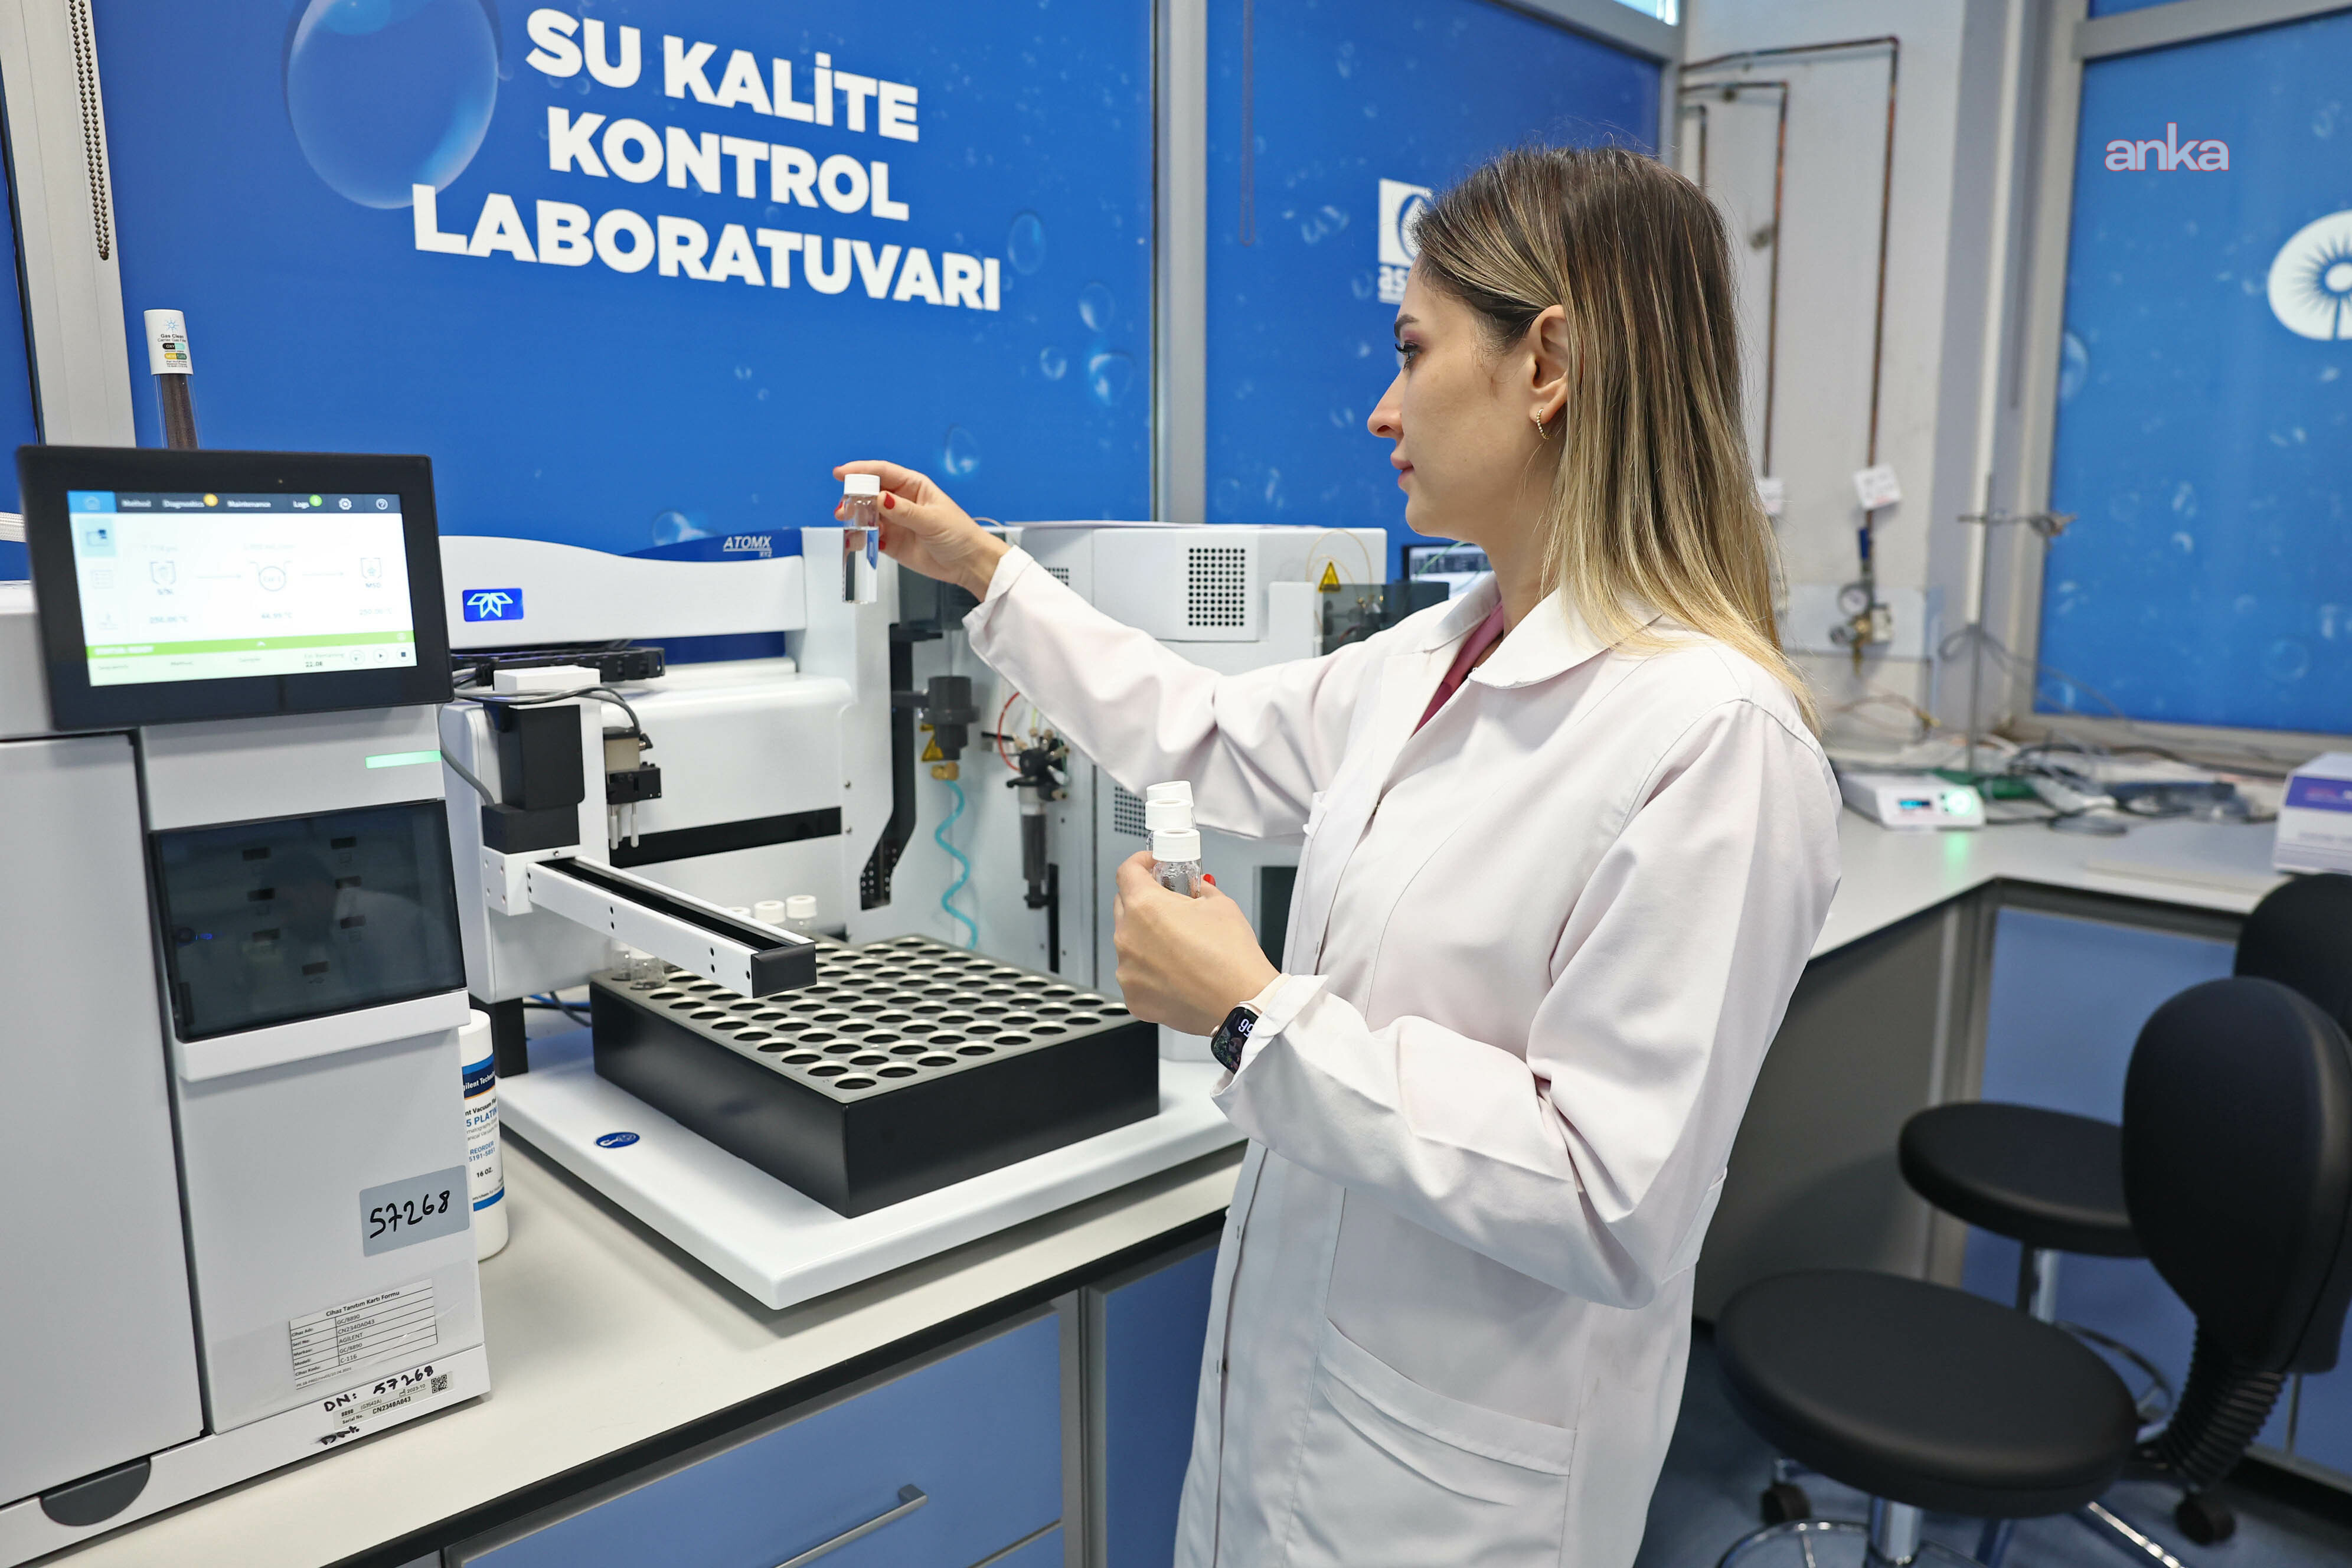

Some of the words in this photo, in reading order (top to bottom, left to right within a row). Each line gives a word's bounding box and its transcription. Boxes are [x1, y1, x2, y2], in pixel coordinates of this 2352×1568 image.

[525, 8, 641, 89] SU
[663, 34, 919, 143] KALİTE
[547, 106, 909, 221] KONTROL
[412, 183, 1000, 311] LABORATUVARI
[162, 499, 205, 508] Diagnostics
[293, 501, 310, 509] Logs
[723, 535, 772, 551] ATOMX
[472, 1102, 492, 1114] Vacuum
[466, 1119, 472, 1127] 5
[469, 1147, 495, 1162] 5191-5851
[470, 1140, 494, 1155] REORDER
[370, 1190, 450, 1239] 57268
[326, 1308, 342, 1317] Cihaz
[343, 1302, 365, 1312] Tanıtım
[367, 1297, 380, 1305] Kartı
[381, 1291, 400, 1301] Formu
[337, 1314, 360, 1325] GC/8890
[338, 1319, 375, 1334] CN2340A043
[339, 1343, 362, 1354] GC/8890
[341, 1354, 357, 1363] C-116
[324, 1393, 357, 1412] DN:
[373, 1366, 434, 1394] 57268
[341, 1409, 354, 1417] 8890
[361, 1399, 382, 1410] (G3542A)
[407, 1383, 426, 1394] 2023-10
[373, 1397, 411, 1415] CN2340A043
